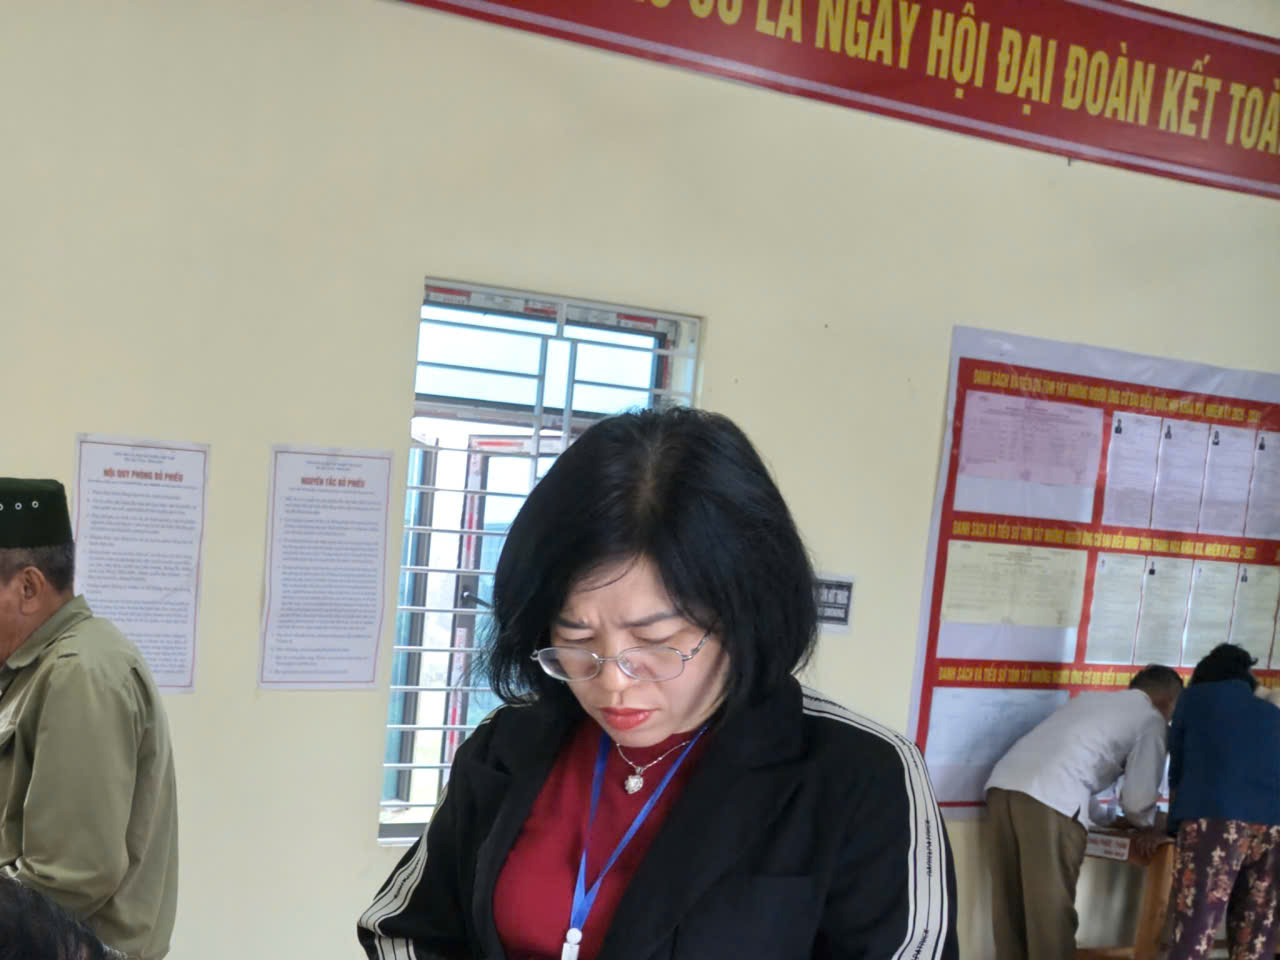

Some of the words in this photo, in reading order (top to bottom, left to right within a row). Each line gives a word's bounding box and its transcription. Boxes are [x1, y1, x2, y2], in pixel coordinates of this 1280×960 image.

[926, 1, 990, 99] HỘI
[996, 26, 1057, 115] ĐẠI
[1062, 41, 1156, 126] ĐOÀN
[1159, 53, 1222, 140] KẾT
[1225, 77, 1280, 155] TOÀ
